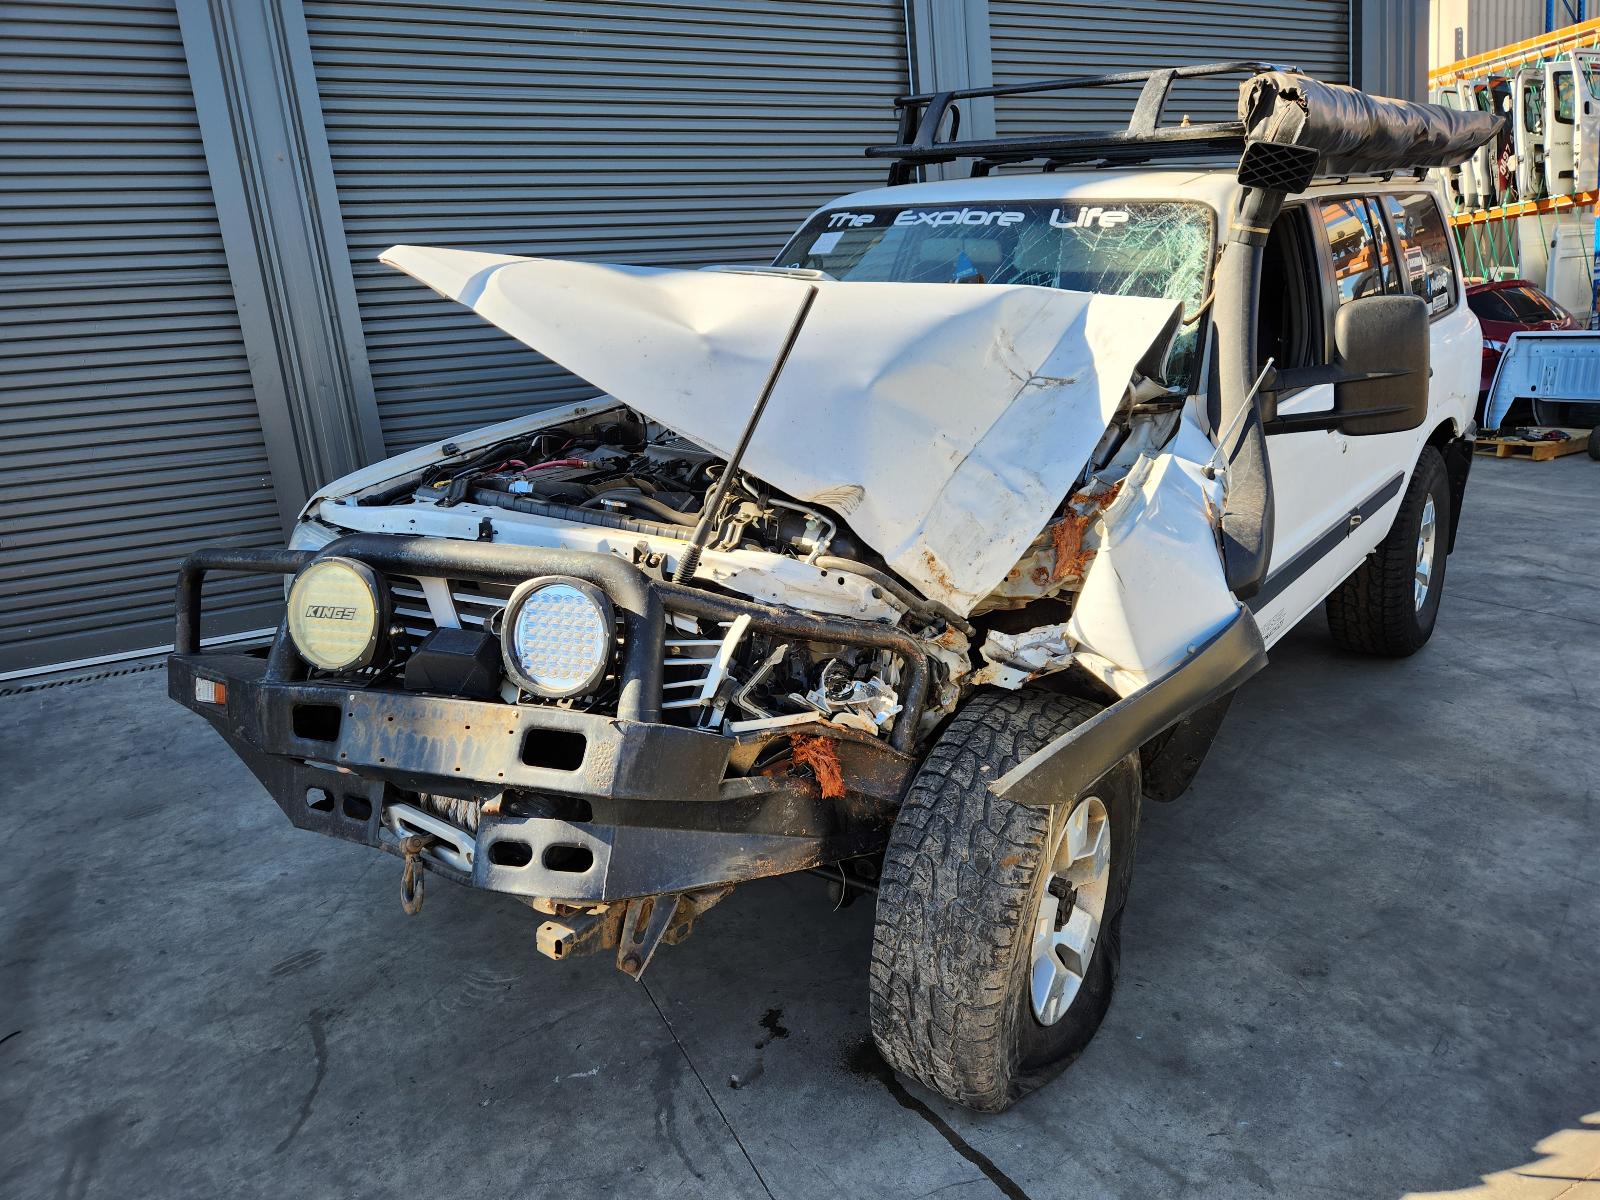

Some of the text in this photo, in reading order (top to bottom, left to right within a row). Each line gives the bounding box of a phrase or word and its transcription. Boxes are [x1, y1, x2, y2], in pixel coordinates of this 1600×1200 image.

[827, 206, 1130, 229] The Explore Life
[305, 605, 356, 620] KINGS
